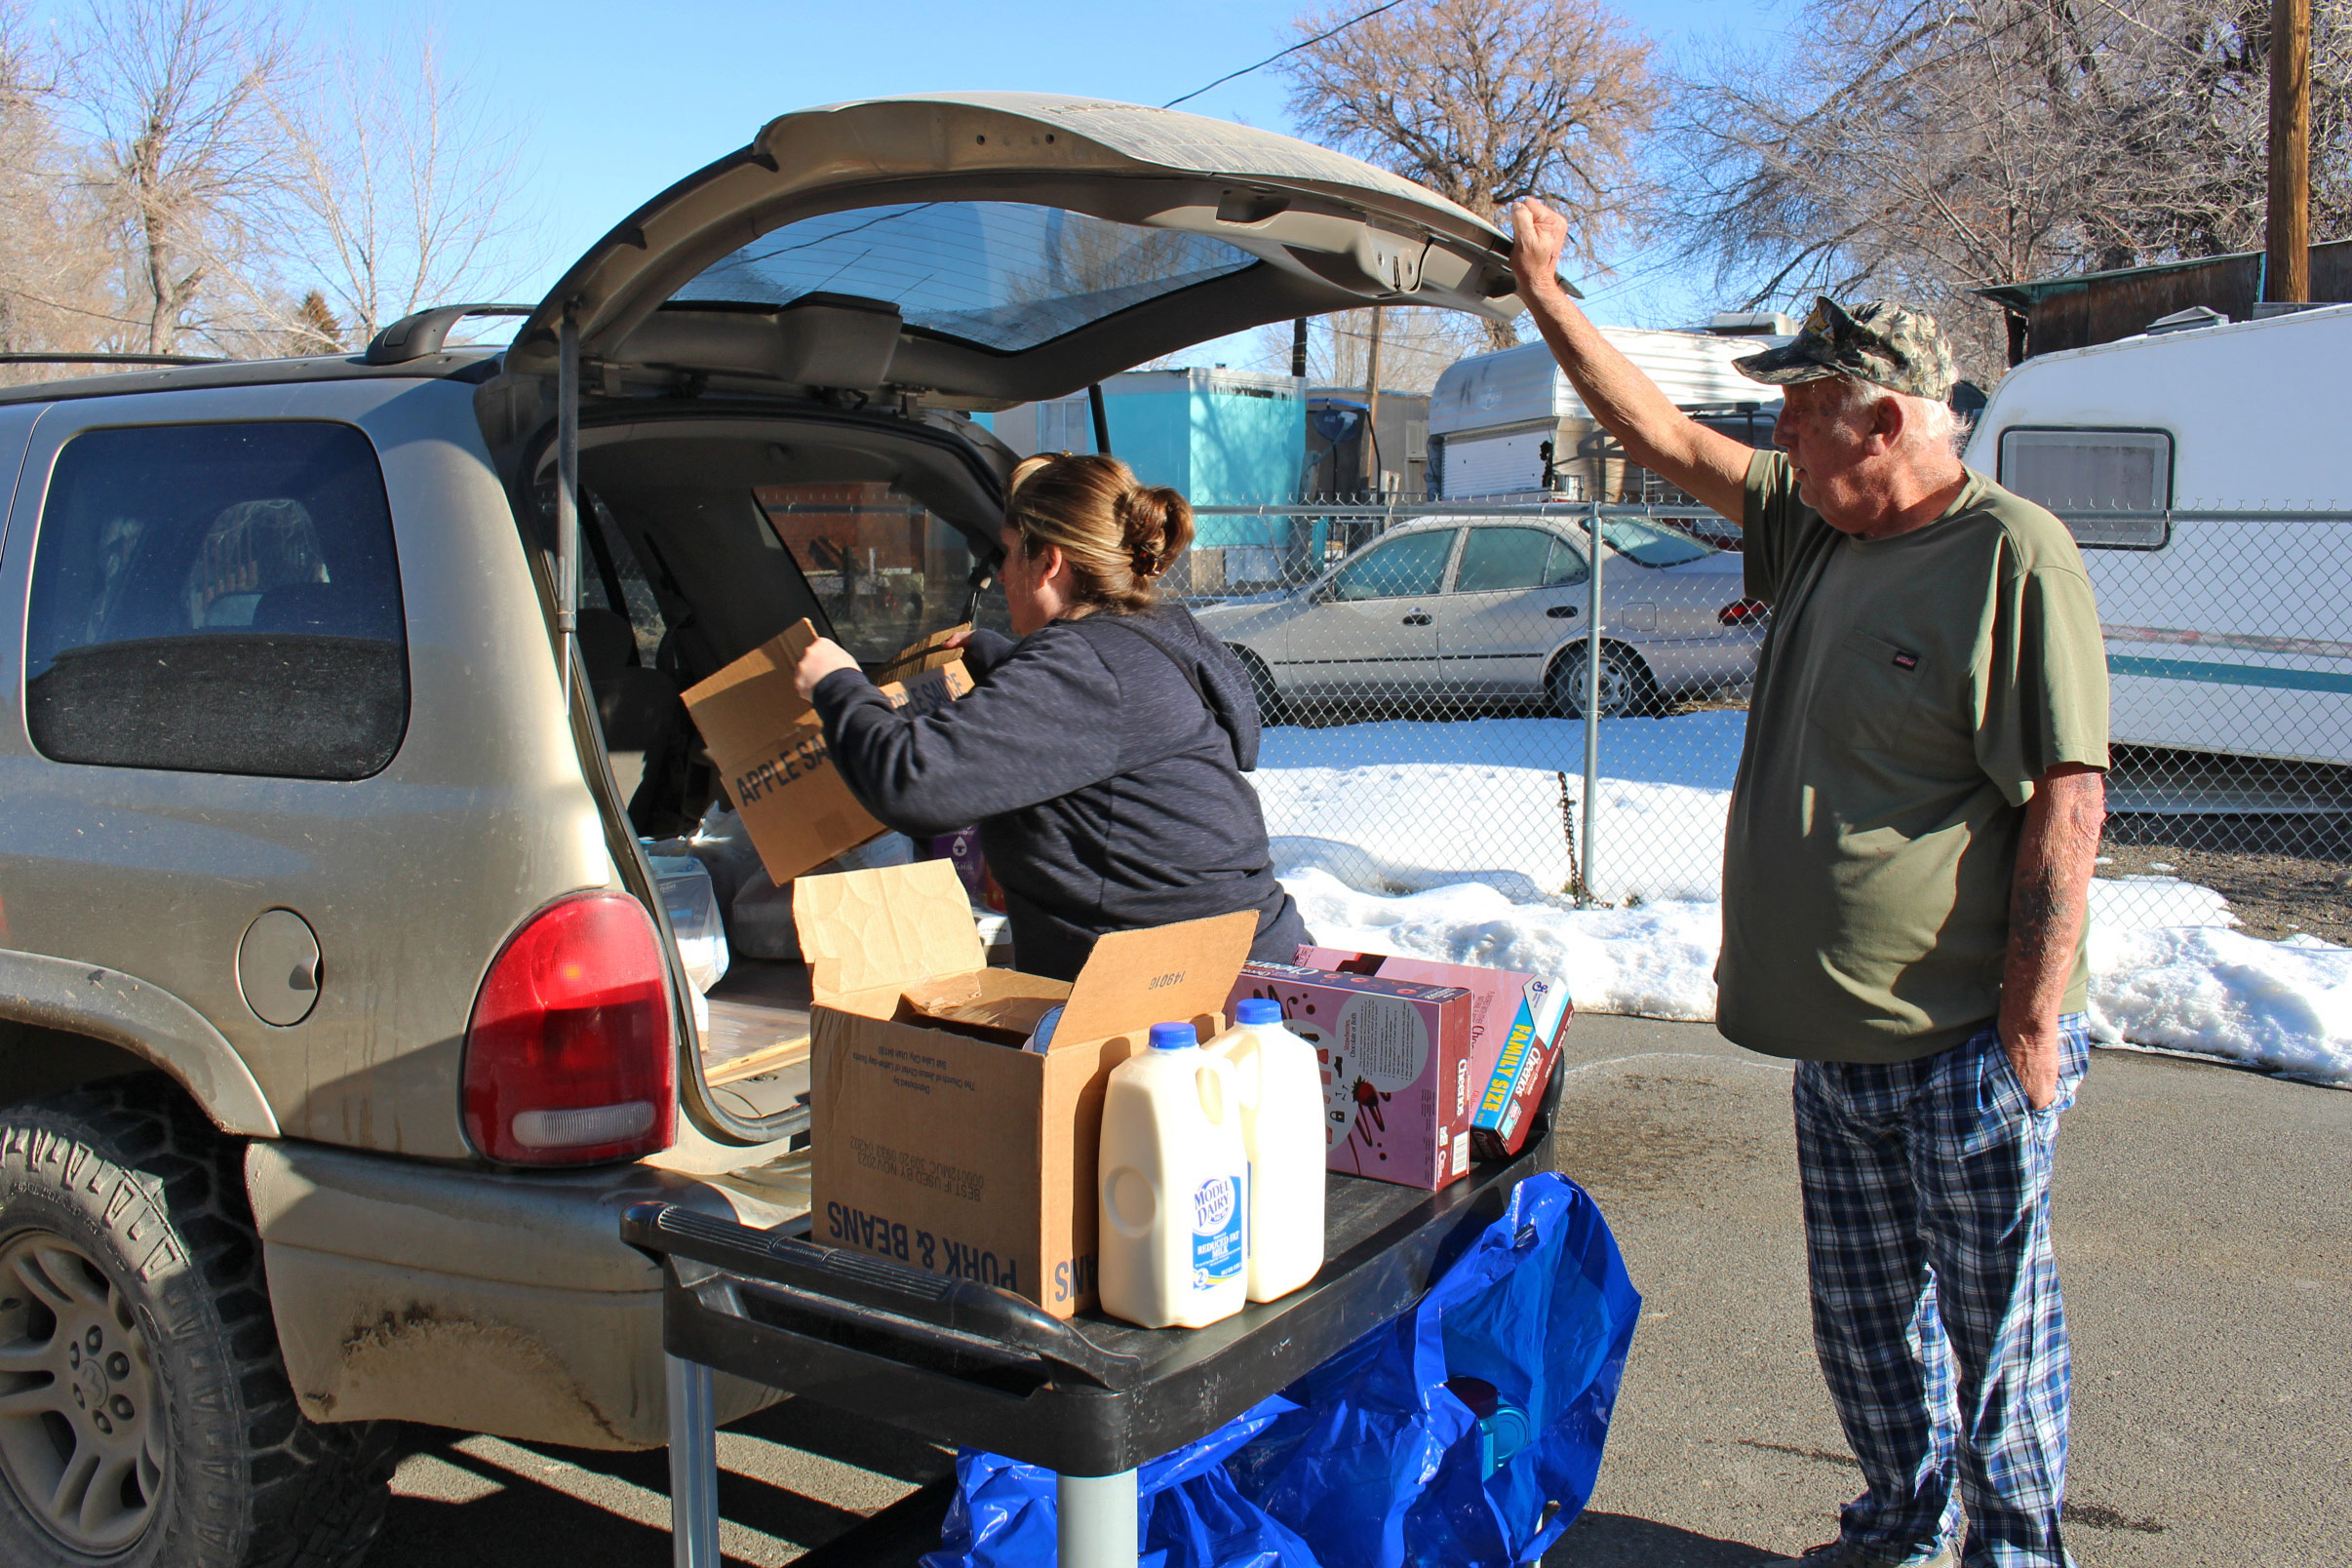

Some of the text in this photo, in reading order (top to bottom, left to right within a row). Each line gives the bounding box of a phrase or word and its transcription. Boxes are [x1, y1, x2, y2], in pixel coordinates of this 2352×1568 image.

[889, 673, 962, 717] PPLE SAUCE
[735, 749, 802, 808] APPLE
[1497, 1024, 1533, 1078] FAMILY
[1457, 1058, 1468, 1117] Cheerios
[1514, 1046, 1542, 1097] Cheerios
[1481, 1078, 1509, 1113] SIZE
[899, 1166, 914, 1182] BY
[916, 1171, 942, 1193] USED
[943, 1181, 953, 1196] IF
[953, 1182, 981, 1202] BEST
[1194, 1180, 1229, 1210] MODEL
[1197, 1194, 1229, 1228] DAIRY
[827, 1200, 1017, 1292] PORK & BEANS
[1197, 1235, 1229, 1255] REDUCED
[1230, 1230, 1240, 1243] FAT
[1212, 1245, 1229, 1259] MILK
[1055, 1254, 1098, 1303] ANS
